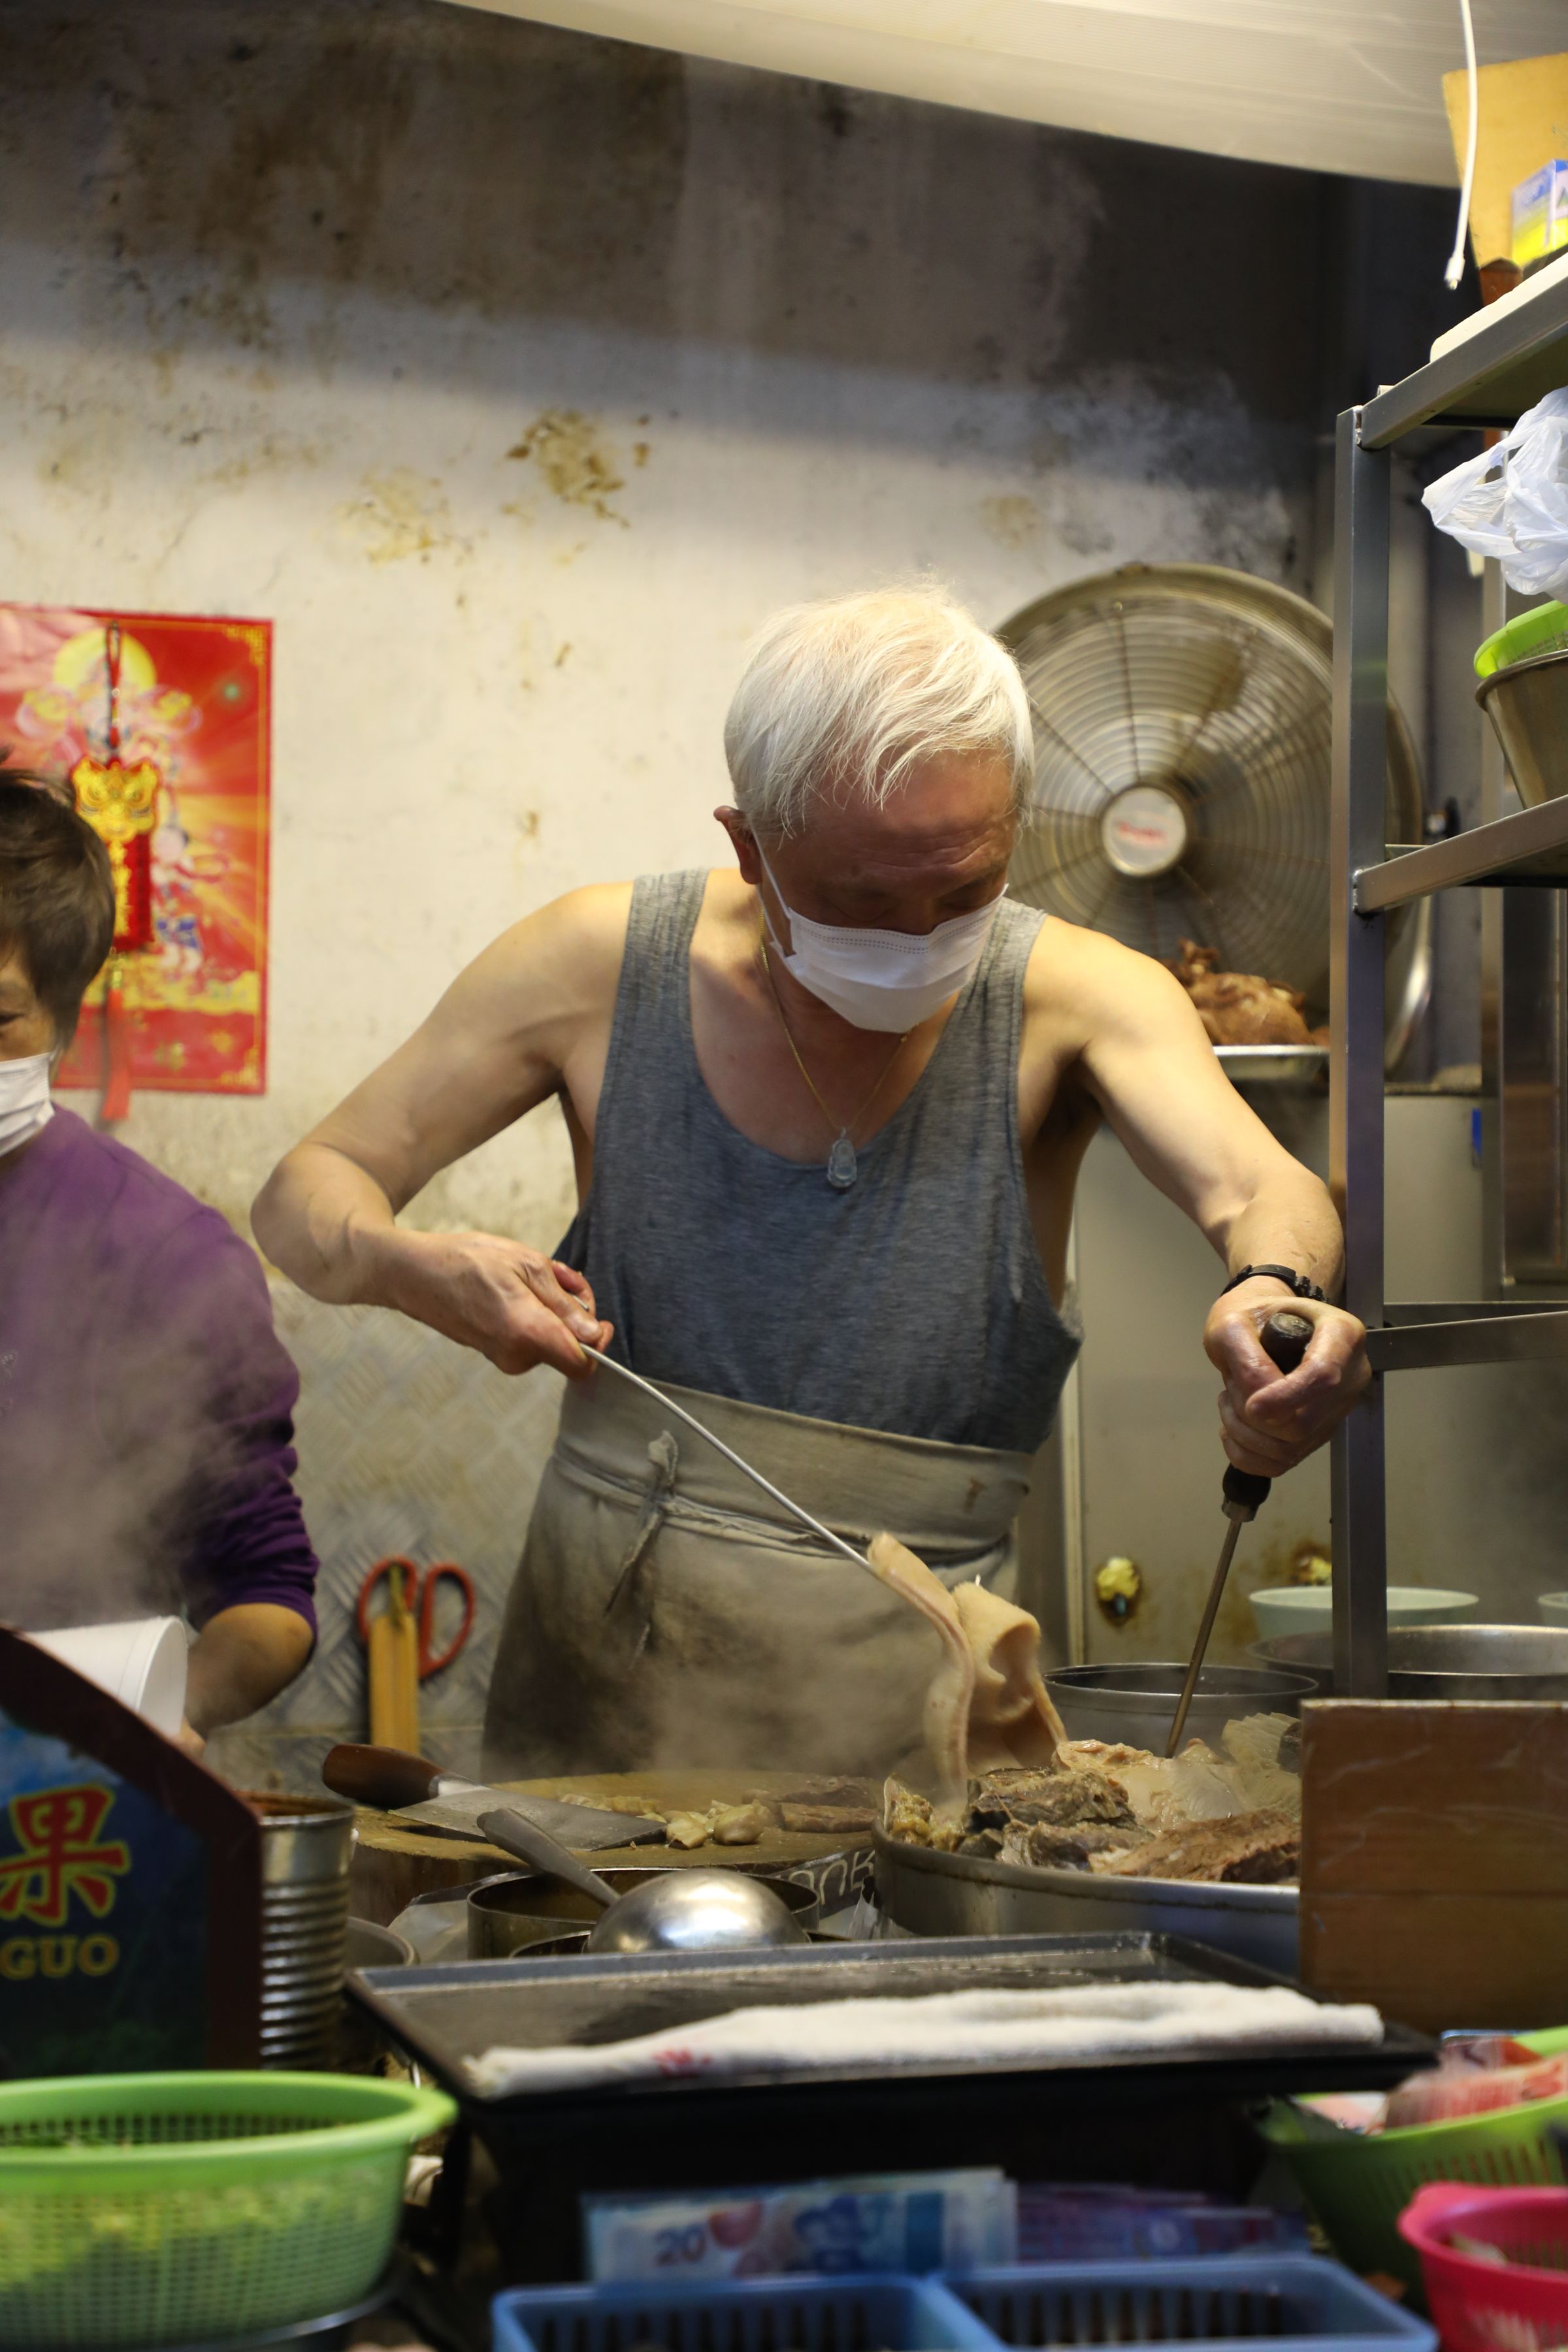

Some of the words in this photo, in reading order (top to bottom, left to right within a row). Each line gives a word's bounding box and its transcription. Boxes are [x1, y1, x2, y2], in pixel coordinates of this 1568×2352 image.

[0, 1784, 131, 1927] 果
[0, 1933, 120, 1980] GUO
[654, 2223, 707, 2268] 20
